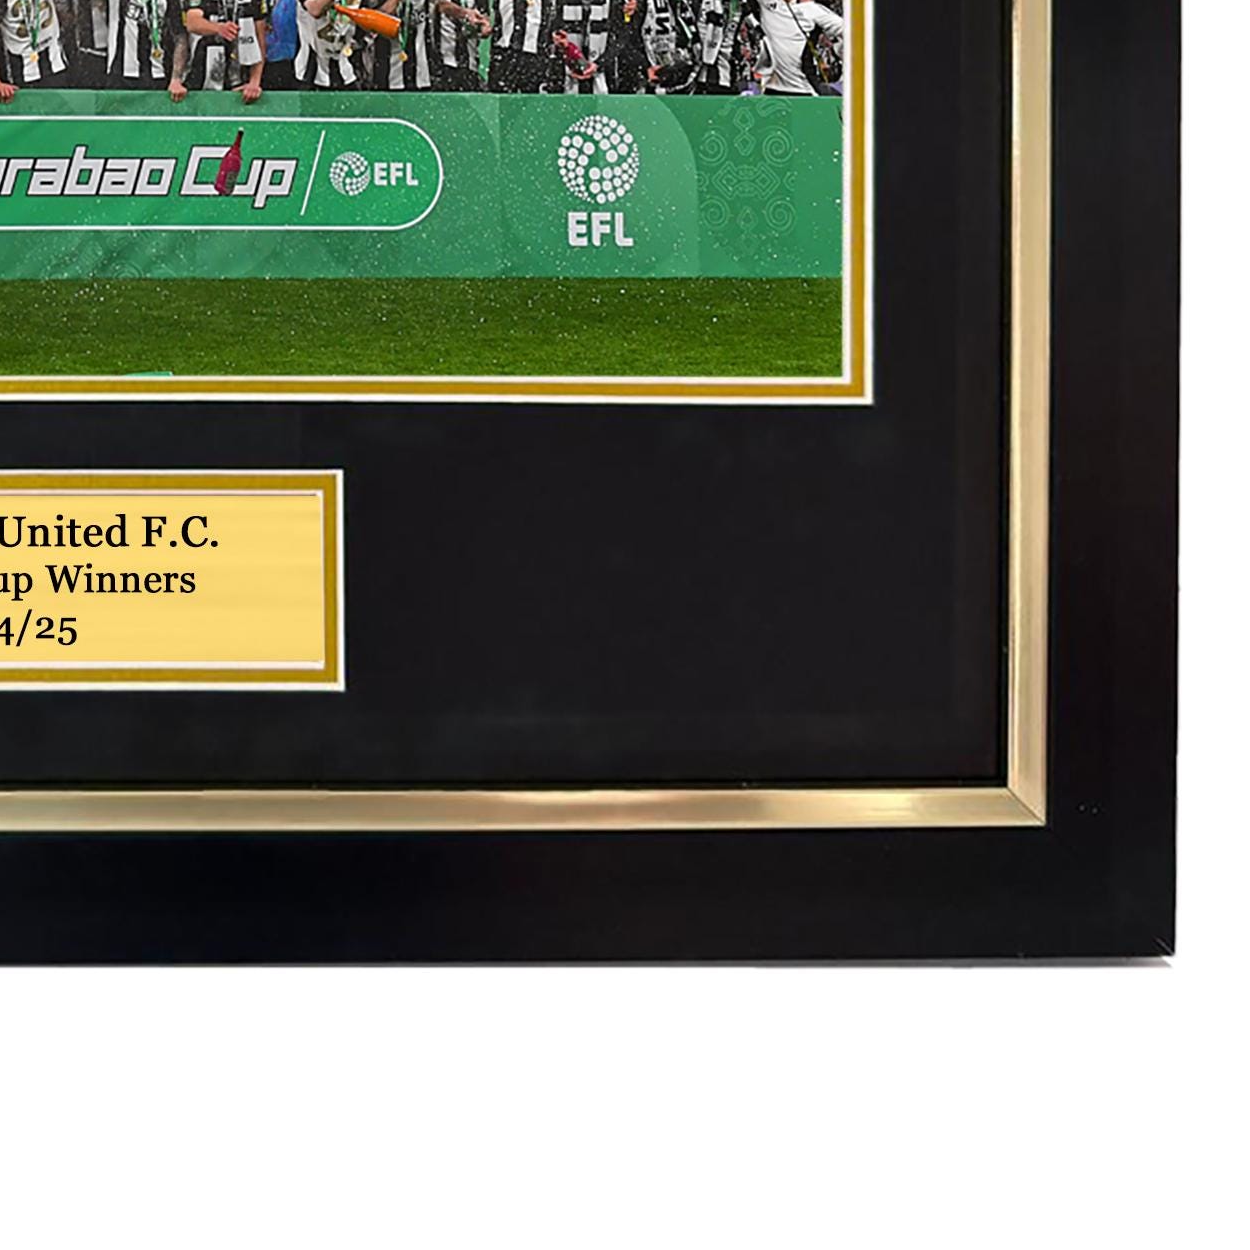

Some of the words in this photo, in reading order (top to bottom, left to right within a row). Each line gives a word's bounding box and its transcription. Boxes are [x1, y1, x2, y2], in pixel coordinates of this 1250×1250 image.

[179, 144, 299, 209] Cup
[373, 161, 419, 187] EFL
[567, 211, 635, 248] EFL
[141, 515, 219, 548] F.C.
[44, 562, 196, 594] Winners
